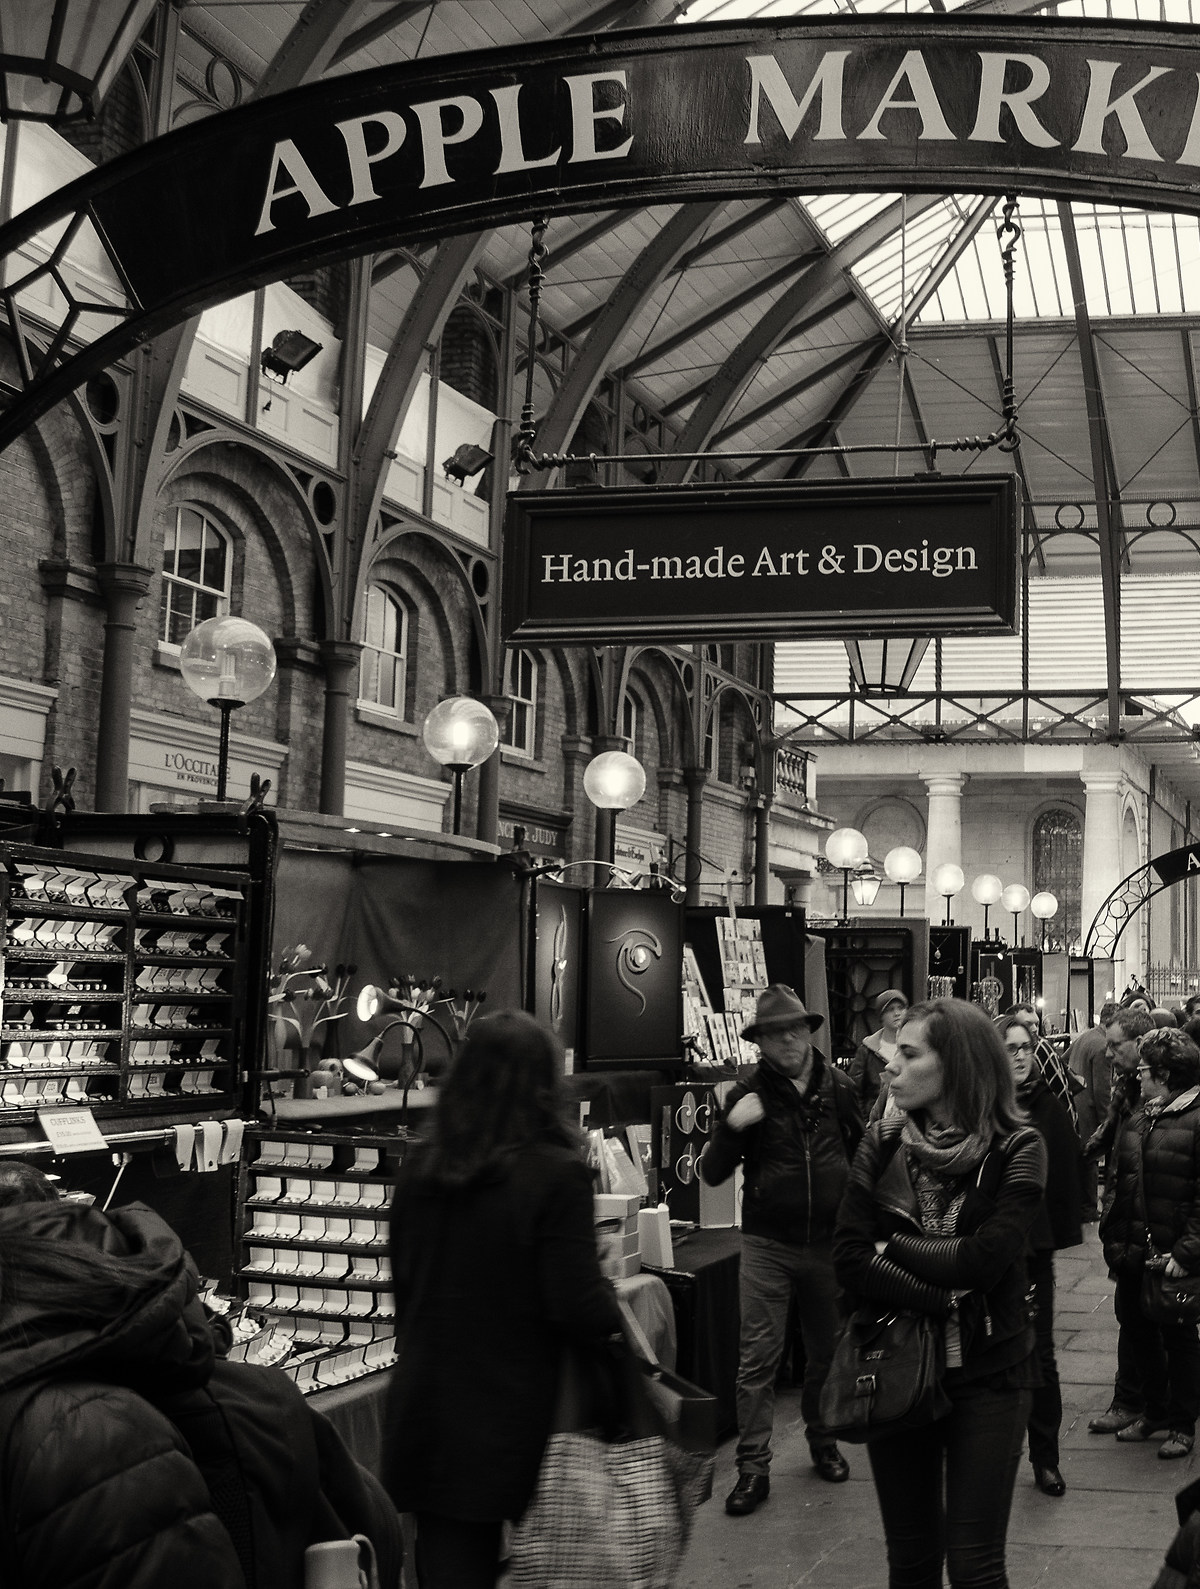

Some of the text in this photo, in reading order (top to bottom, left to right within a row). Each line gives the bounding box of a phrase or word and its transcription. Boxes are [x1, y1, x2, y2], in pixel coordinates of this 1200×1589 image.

[253, 69, 636, 237] APPLE
[541, 539, 979, 583] Hand-made Art & Design
[532, 827, 558, 846] JUDY
